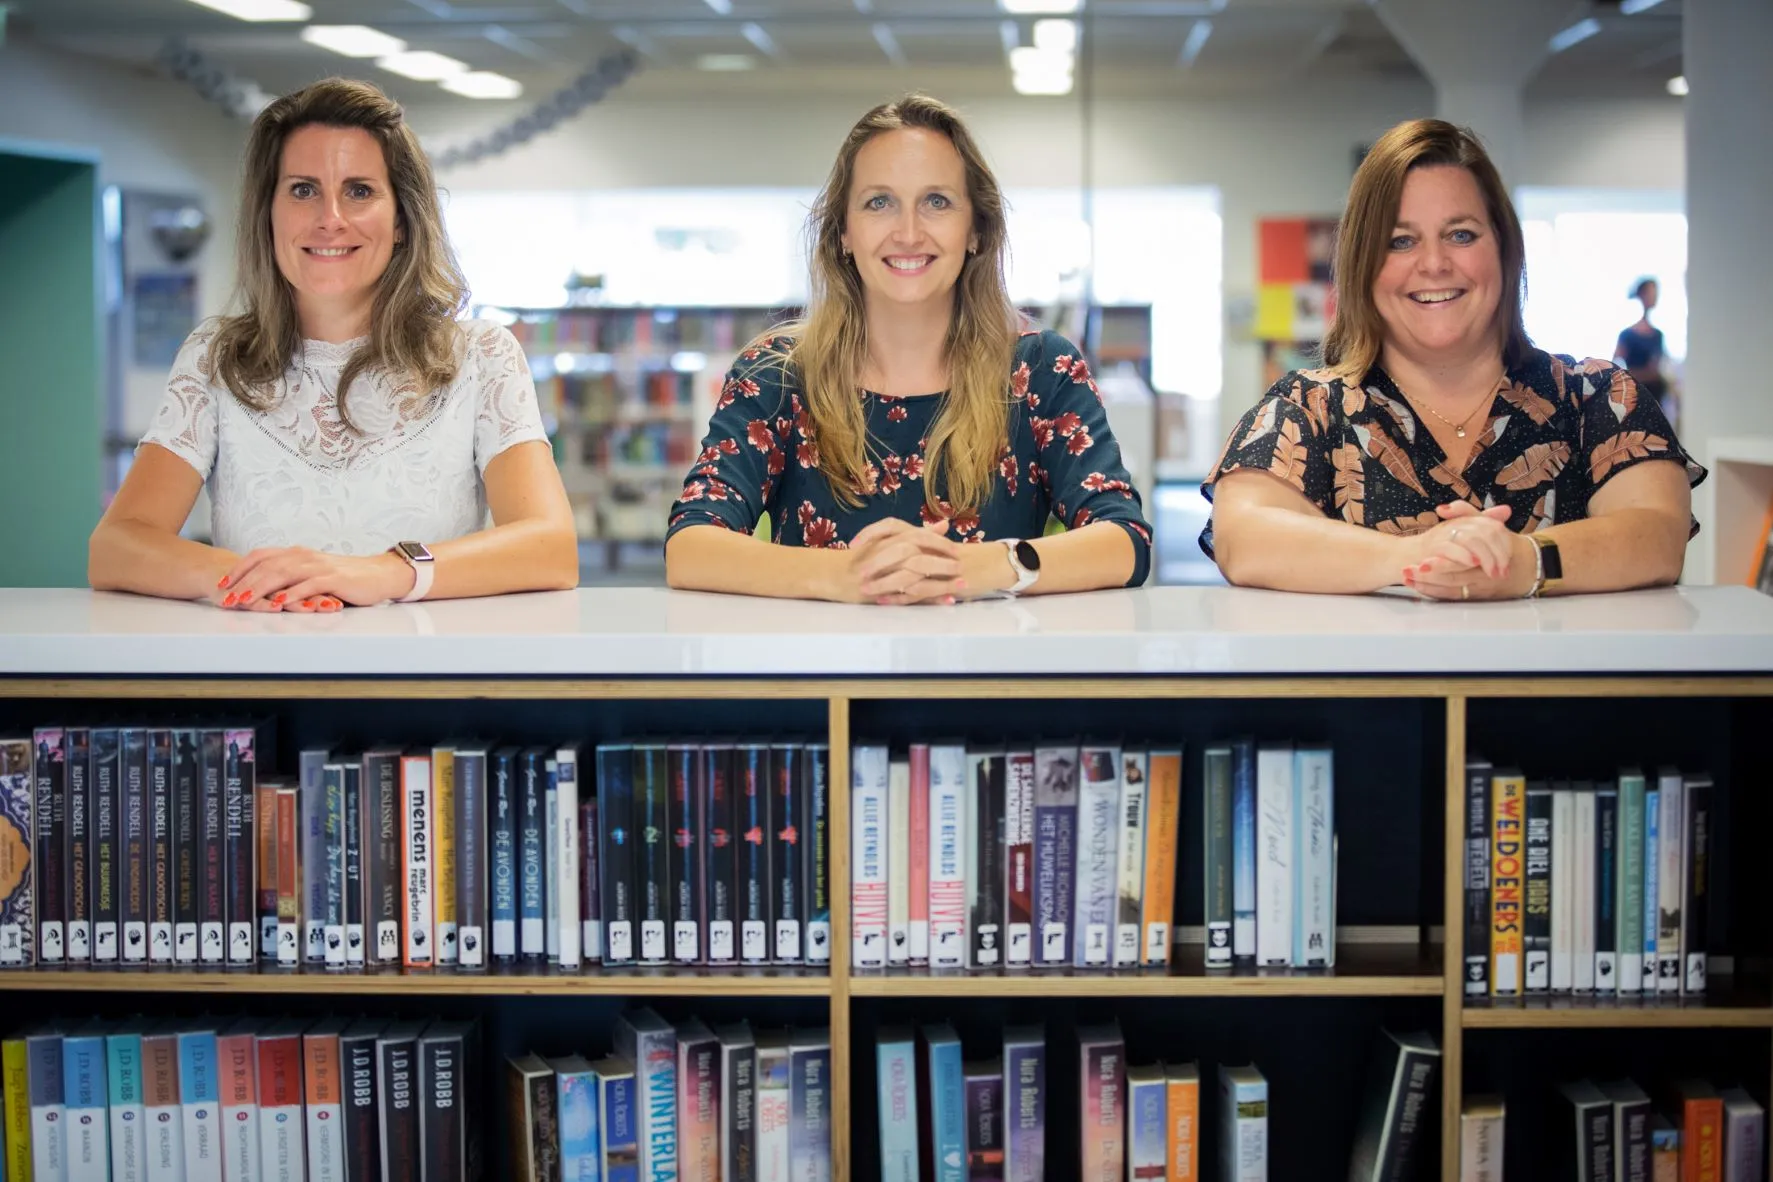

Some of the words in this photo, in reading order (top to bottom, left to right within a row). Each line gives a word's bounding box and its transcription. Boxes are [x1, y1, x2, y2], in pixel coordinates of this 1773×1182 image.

[72, 766, 83, 791] RUTH
[100, 768, 110, 792] RUTH
[129, 766, 140, 792] RUTH
[155, 767, 166, 792] RUTH
[206, 768, 217, 793] RUTH
[1505, 784, 1517, 797] DE
[38, 778, 51, 838] RENDELL
[72, 794, 83, 838] RENDELL
[100, 796, 110, 838] RENDELL
[129, 795, 140, 838] RENDELL
[155, 796, 166, 838] RENDELL
[206, 797, 217, 840] RENDELL
[228, 778, 241, 840] RENDELL
[380, 781, 393, 840] BESLISSING
[864, 797, 878, 823] ALLIE
[941, 795, 956, 822] ALLIE
[1126, 793, 1142, 828] Trouw
[413, 790, 427, 863] menens
[496, 830, 510, 848] DE
[525, 828, 538, 845] DE
[645, 826, 658, 843] 2
[713, 828, 727, 847] 3
[1040, 814, 1056, 838] HET
[1057, 815, 1069, 867] MICHELLE
[1091, 800, 1107, 872] WONDEN
[100, 843, 110, 858] HET
[864, 826, 878, 878] REYNOLDS
[941, 825, 956, 876] REYNOLDS
[1470, 839, 1488, 889] WERELD
[1495, 798, 1521, 933] WELDOENERS
[74, 860, 83, 921] GENOOTSCHA
[156, 862, 166, 922] GENOOTSCHA
[409, 869, 421, 922] reugebrin
[419, 869, 427, 894] marc
[495, 850, 510, 910] AVONDEN
[525, 848, 538, 909] AVONDEN
[1039, 841, 1054, 929] HUWELIJKSPA
[1057, 871, 1069, 922] RICHMO
[1526, 880, 1549, 914] HARS
[118, 1048, 132, 1068] J.D.
[153, 1048, 169, 1067] J.D.
[231, 1048, 246, 1067] J.D.
[698, 1052, 712, 1078] Nora
[737, 1059, 752, 1086] Nora
[805, 1059, 823, 1085] Nora
[1020, 1058, 1039, 1083] Nora
[1100, 1055, 1118, 1080] Nora
[80, 1074, 92, 1105] ROBB
[120, 1069, 134, 1101] ROBB
[156, 1069, 171, 1103] ROBB
[193, 1065, 207, 1099] ROBB
[234, 1069, 247, 1101] ROBB
[316, 1068, 329, 1100] ROBB
[1409, 1062, 1431, 1088] Nora
[13, 1092, 29, 1132] Robben
[697, 1081, 712, 1123] Roberts
[737, 1088, 752, 1131] Roberts
[805, 1088, 823, 1130] Roberts
[978, 1087, 992, 1111] NORA
[1020, 1087, 1040, 1128] Roberts
[1099, 1084, 1118, 1127] Roberts
[1400, 1092, 1425, 1133] Roberts
[650, 1069, 676, 1182] WINTERLA
[979, 1112, 994, 1146] ROBERTS
[1593, 1115, 1609, 1142] Nora
[1630, 1114, 1646, 1140] Nora
